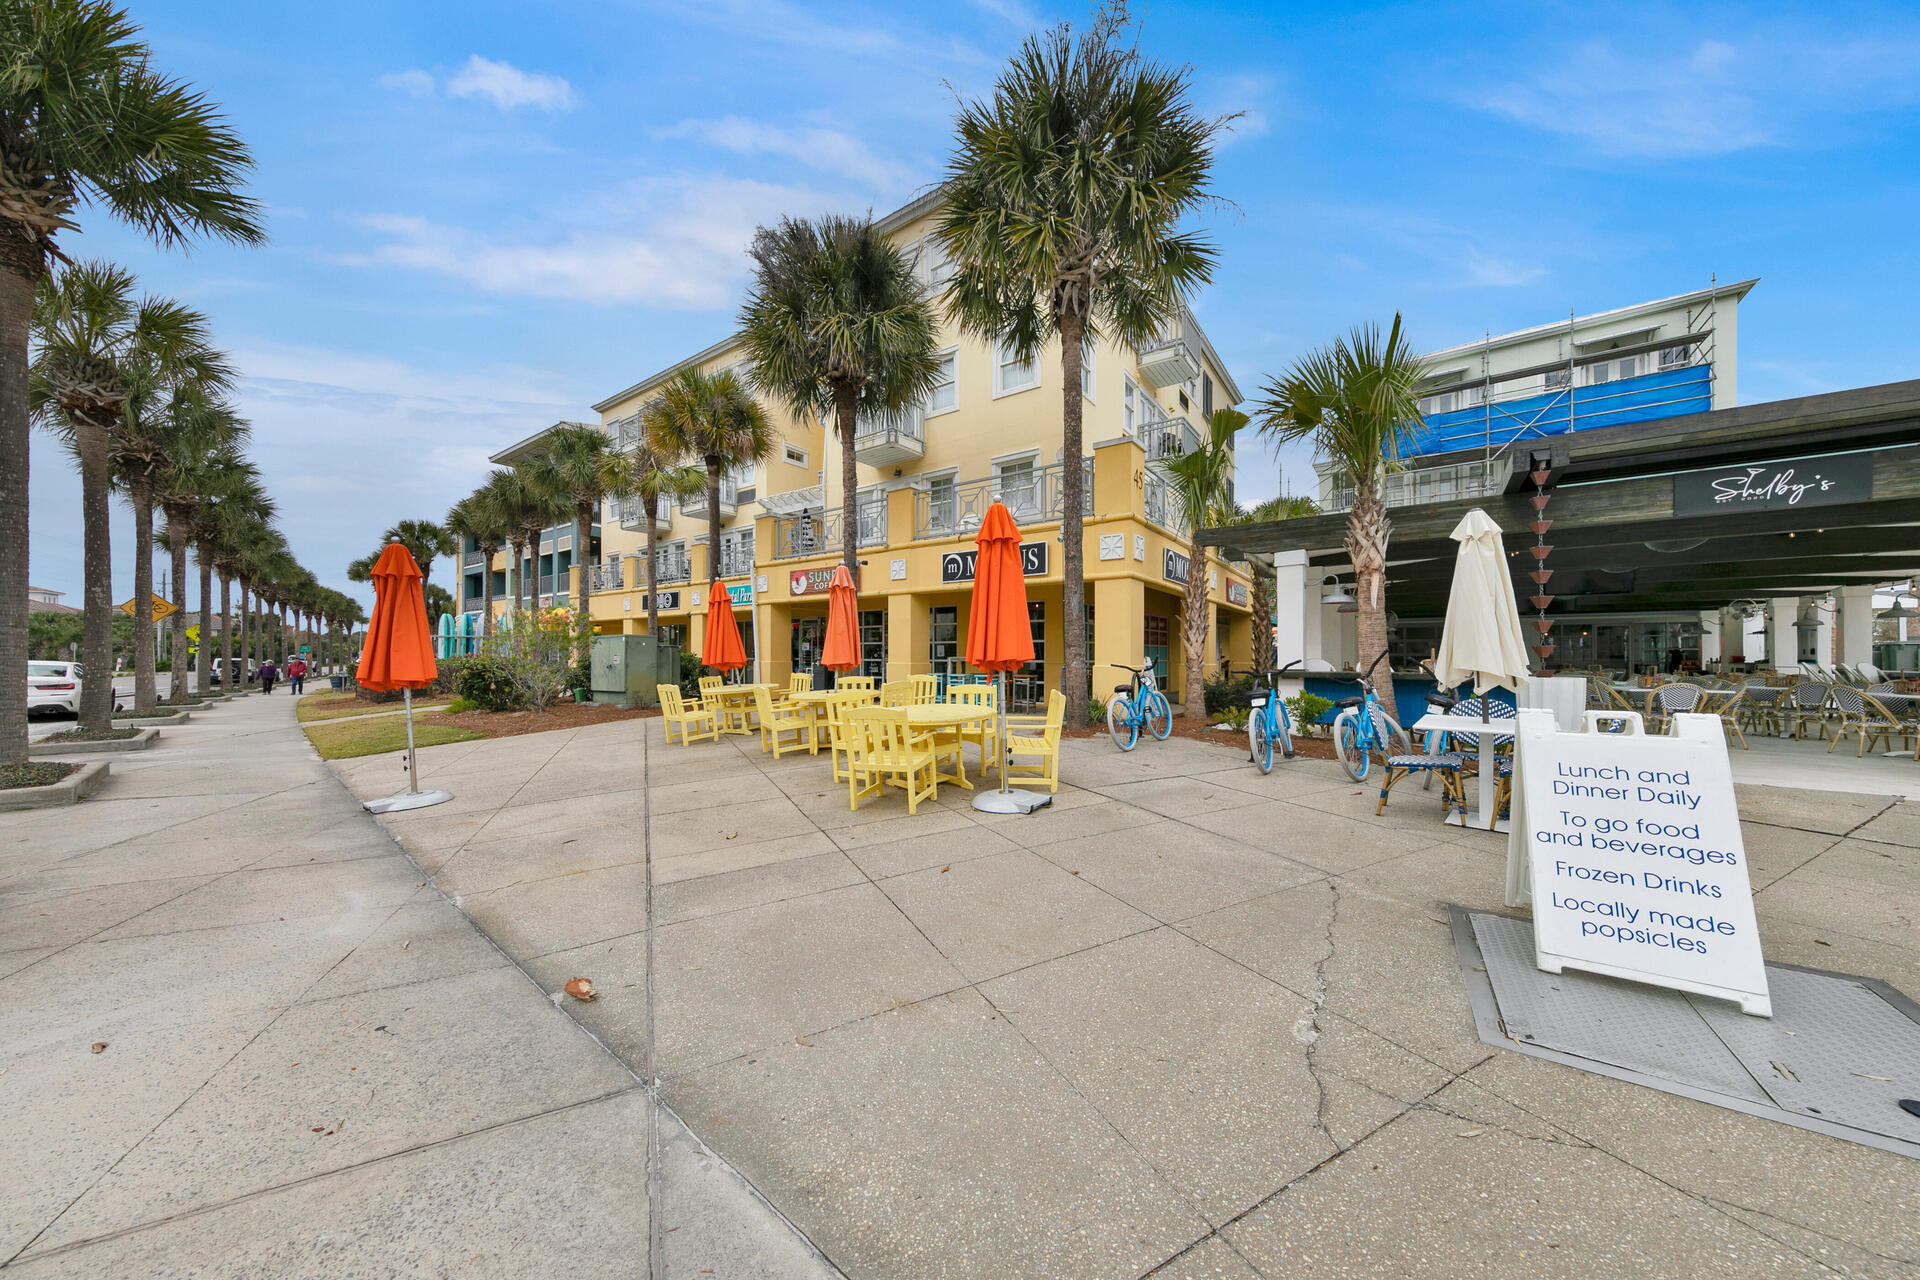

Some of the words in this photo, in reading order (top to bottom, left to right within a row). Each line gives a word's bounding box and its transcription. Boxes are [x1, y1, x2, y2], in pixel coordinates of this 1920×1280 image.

[1133, 468, 1144, 491] 45
[1711, 468, 1836, 505] Shelby's
[1558, 761, 1630, 781] Lunch
[1638, 770, 1690, 786] and
[1553, 780, 1629, 800] Dinner
[1637, 786, 1701, 810] Daily
[1559, 810, 1587, 827] To
[1594, 818, 1629, 833] go
[1635, 818, 1700, 840] food
[1536, 831, 1583, 847] and
[1591, 833, 1737, 866] beverages
[1556, 860, 1635, 886] Frozen
[1644, 872, 1722, 899] Drinks
[1552, 892, 1640, 924] Locally
[1649, 910, 1736, 936] made
[1581, 920, 1708, 954] popsicles
